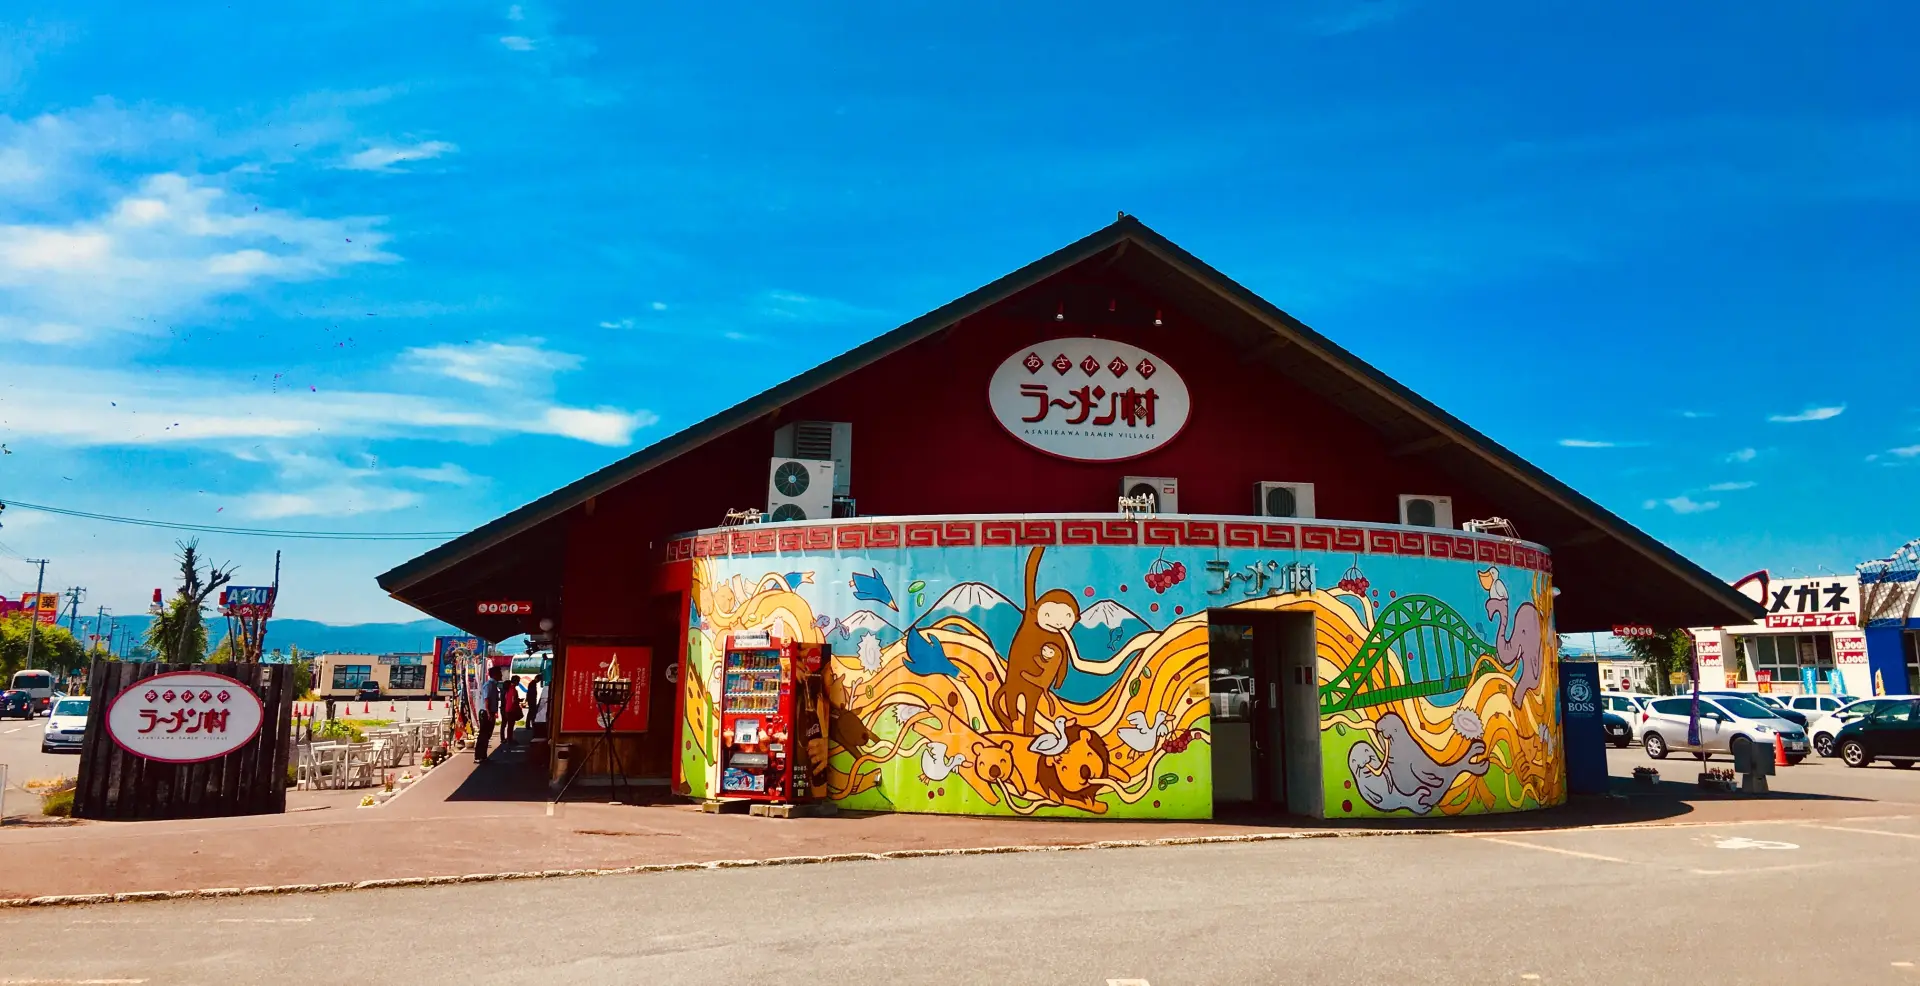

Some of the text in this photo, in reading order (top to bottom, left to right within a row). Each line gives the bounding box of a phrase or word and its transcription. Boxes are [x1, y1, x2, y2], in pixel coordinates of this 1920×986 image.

[1025, 353, 1155, 376] あさひかわ
[1024, 429, 1155, 440] ASAHIKAWA RAMEN VILLAGE
[41, 596, 56, 608] 薬
[1769, 582, 1850, 613] メガネ
[1769, 613, 1855, 627] ドクターアイズ
[1568, 702, 1595, 712] BOSS
